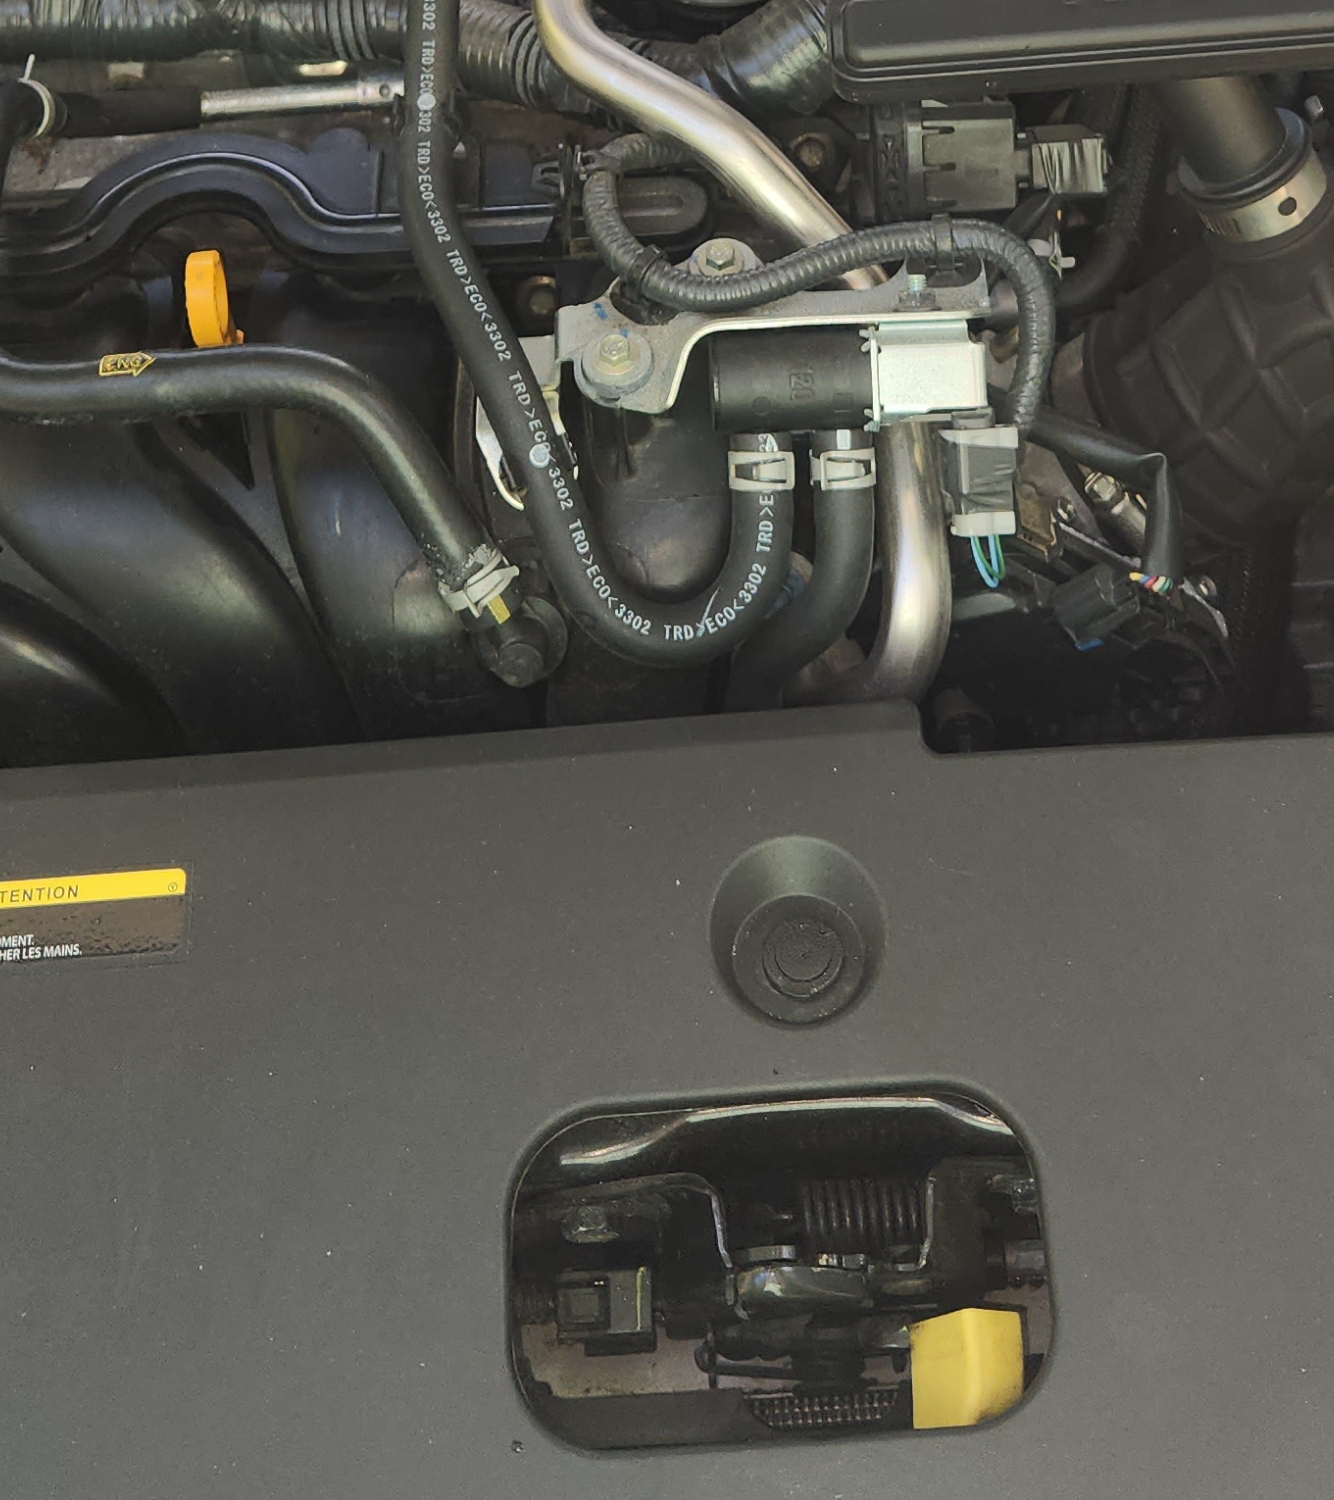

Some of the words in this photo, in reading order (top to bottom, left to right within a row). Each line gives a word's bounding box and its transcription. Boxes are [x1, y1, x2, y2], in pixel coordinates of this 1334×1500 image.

[105, 355, 142, 372] ENG
[23, 946, 41, 959] LES
[42, 943, 82, 958] MAINS.
